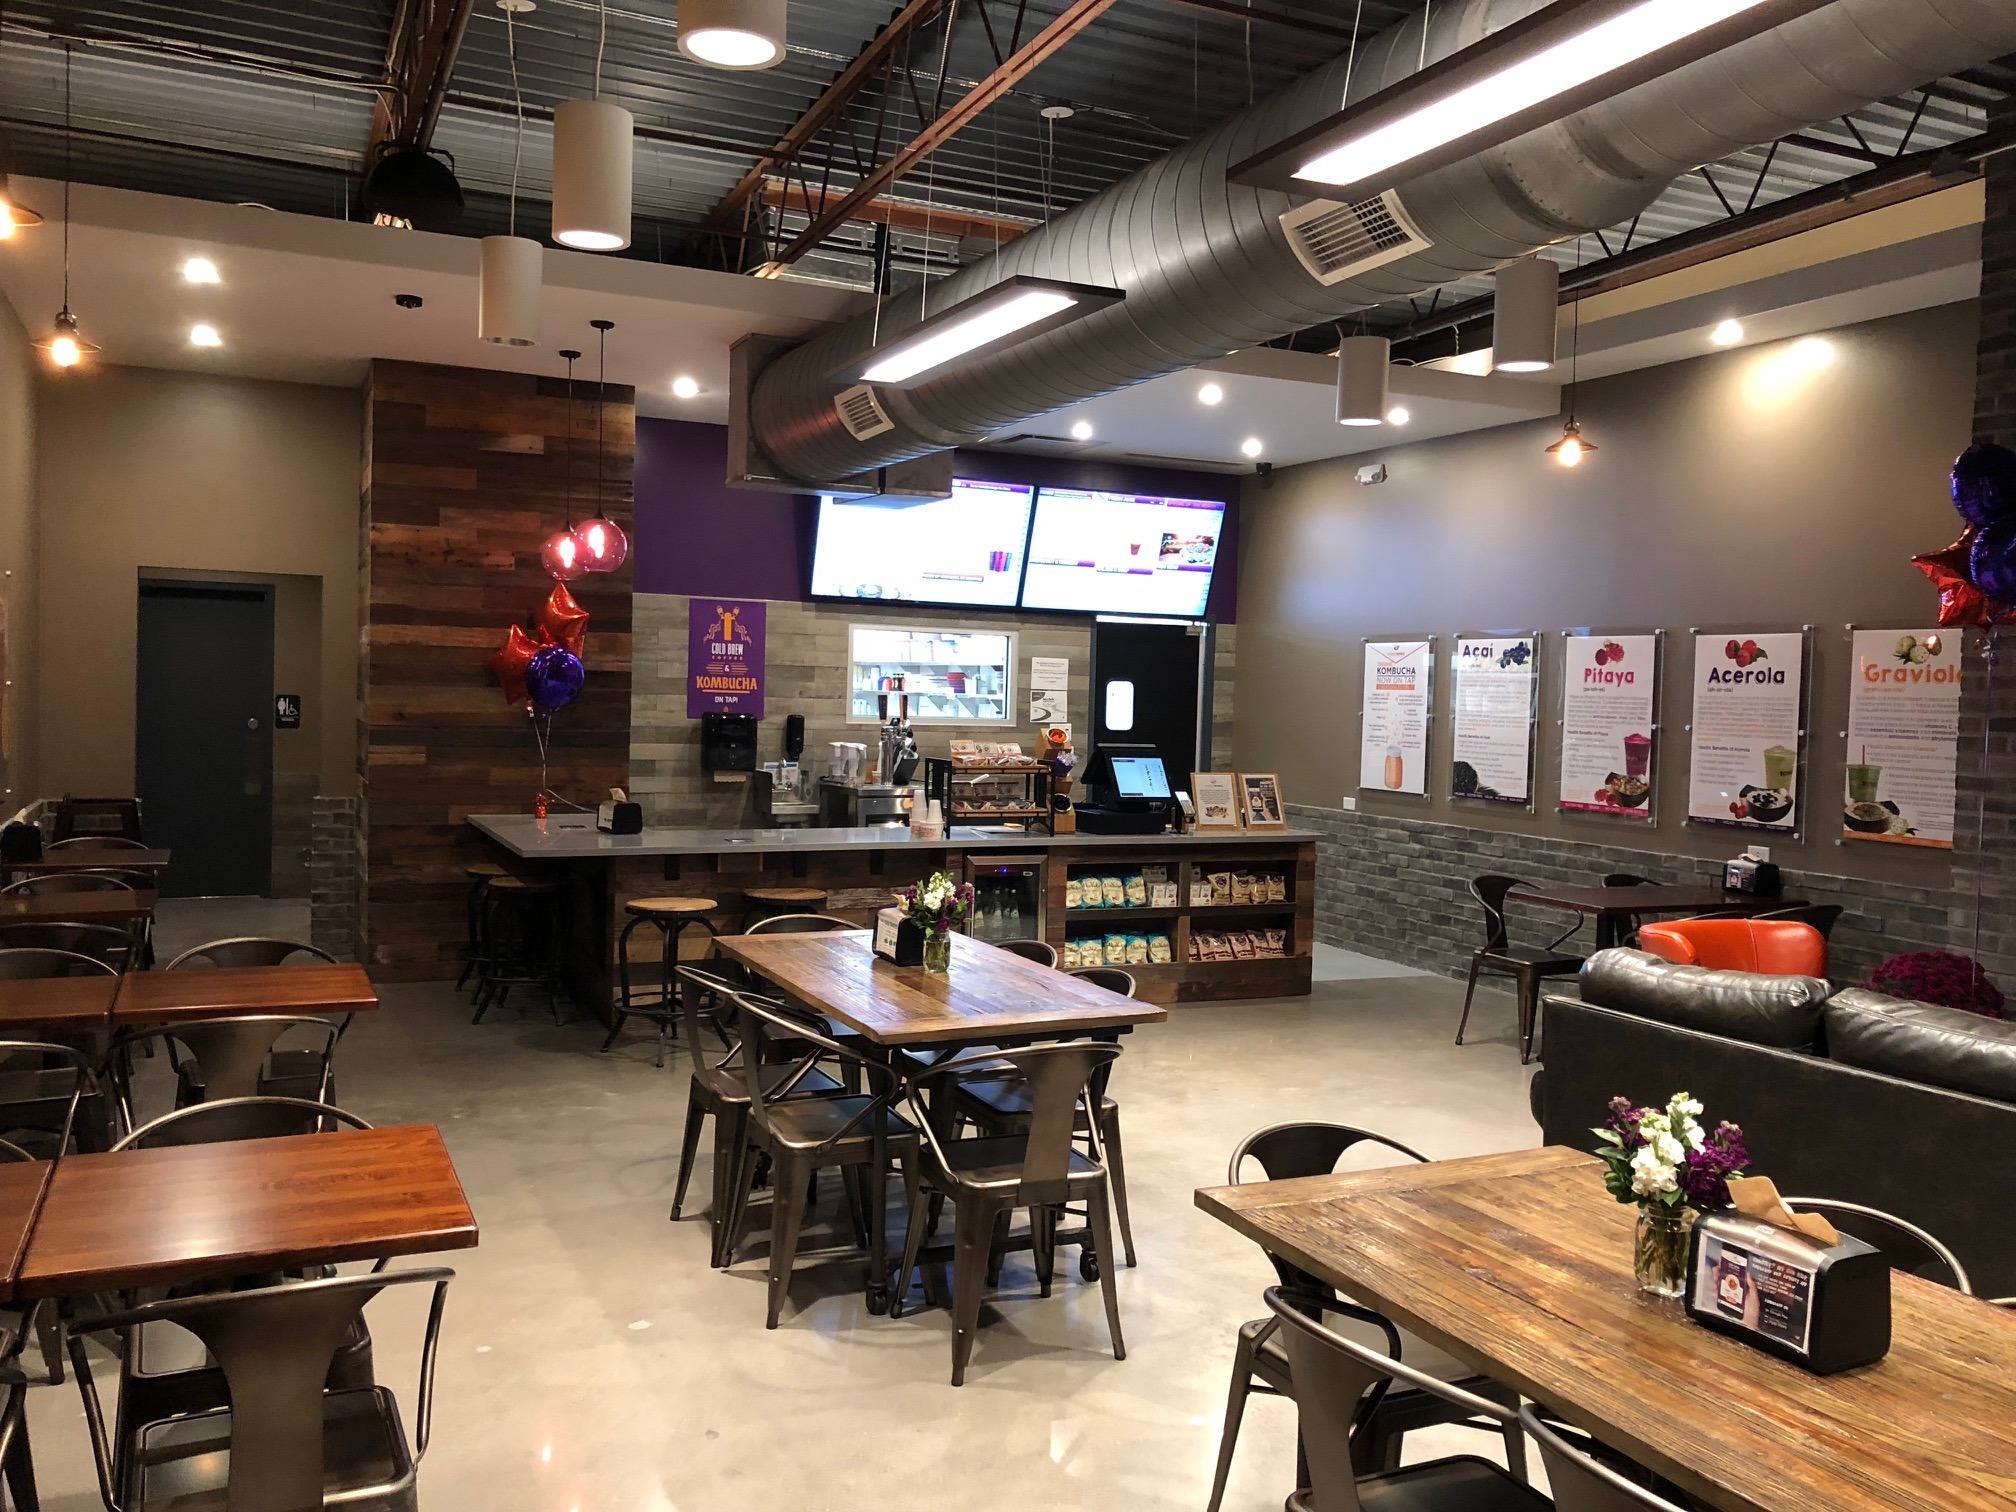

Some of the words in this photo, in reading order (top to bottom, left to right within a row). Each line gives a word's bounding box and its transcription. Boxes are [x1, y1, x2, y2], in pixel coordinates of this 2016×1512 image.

[712, 642, 725, 655] COLD
[728, 643, 744, 655] BREW
[696, 676, 758, 690] KOMBUCHA
[1584, 668, 1635, 687] Pitaya
[1708, 666, 1785, 684] Acerola
